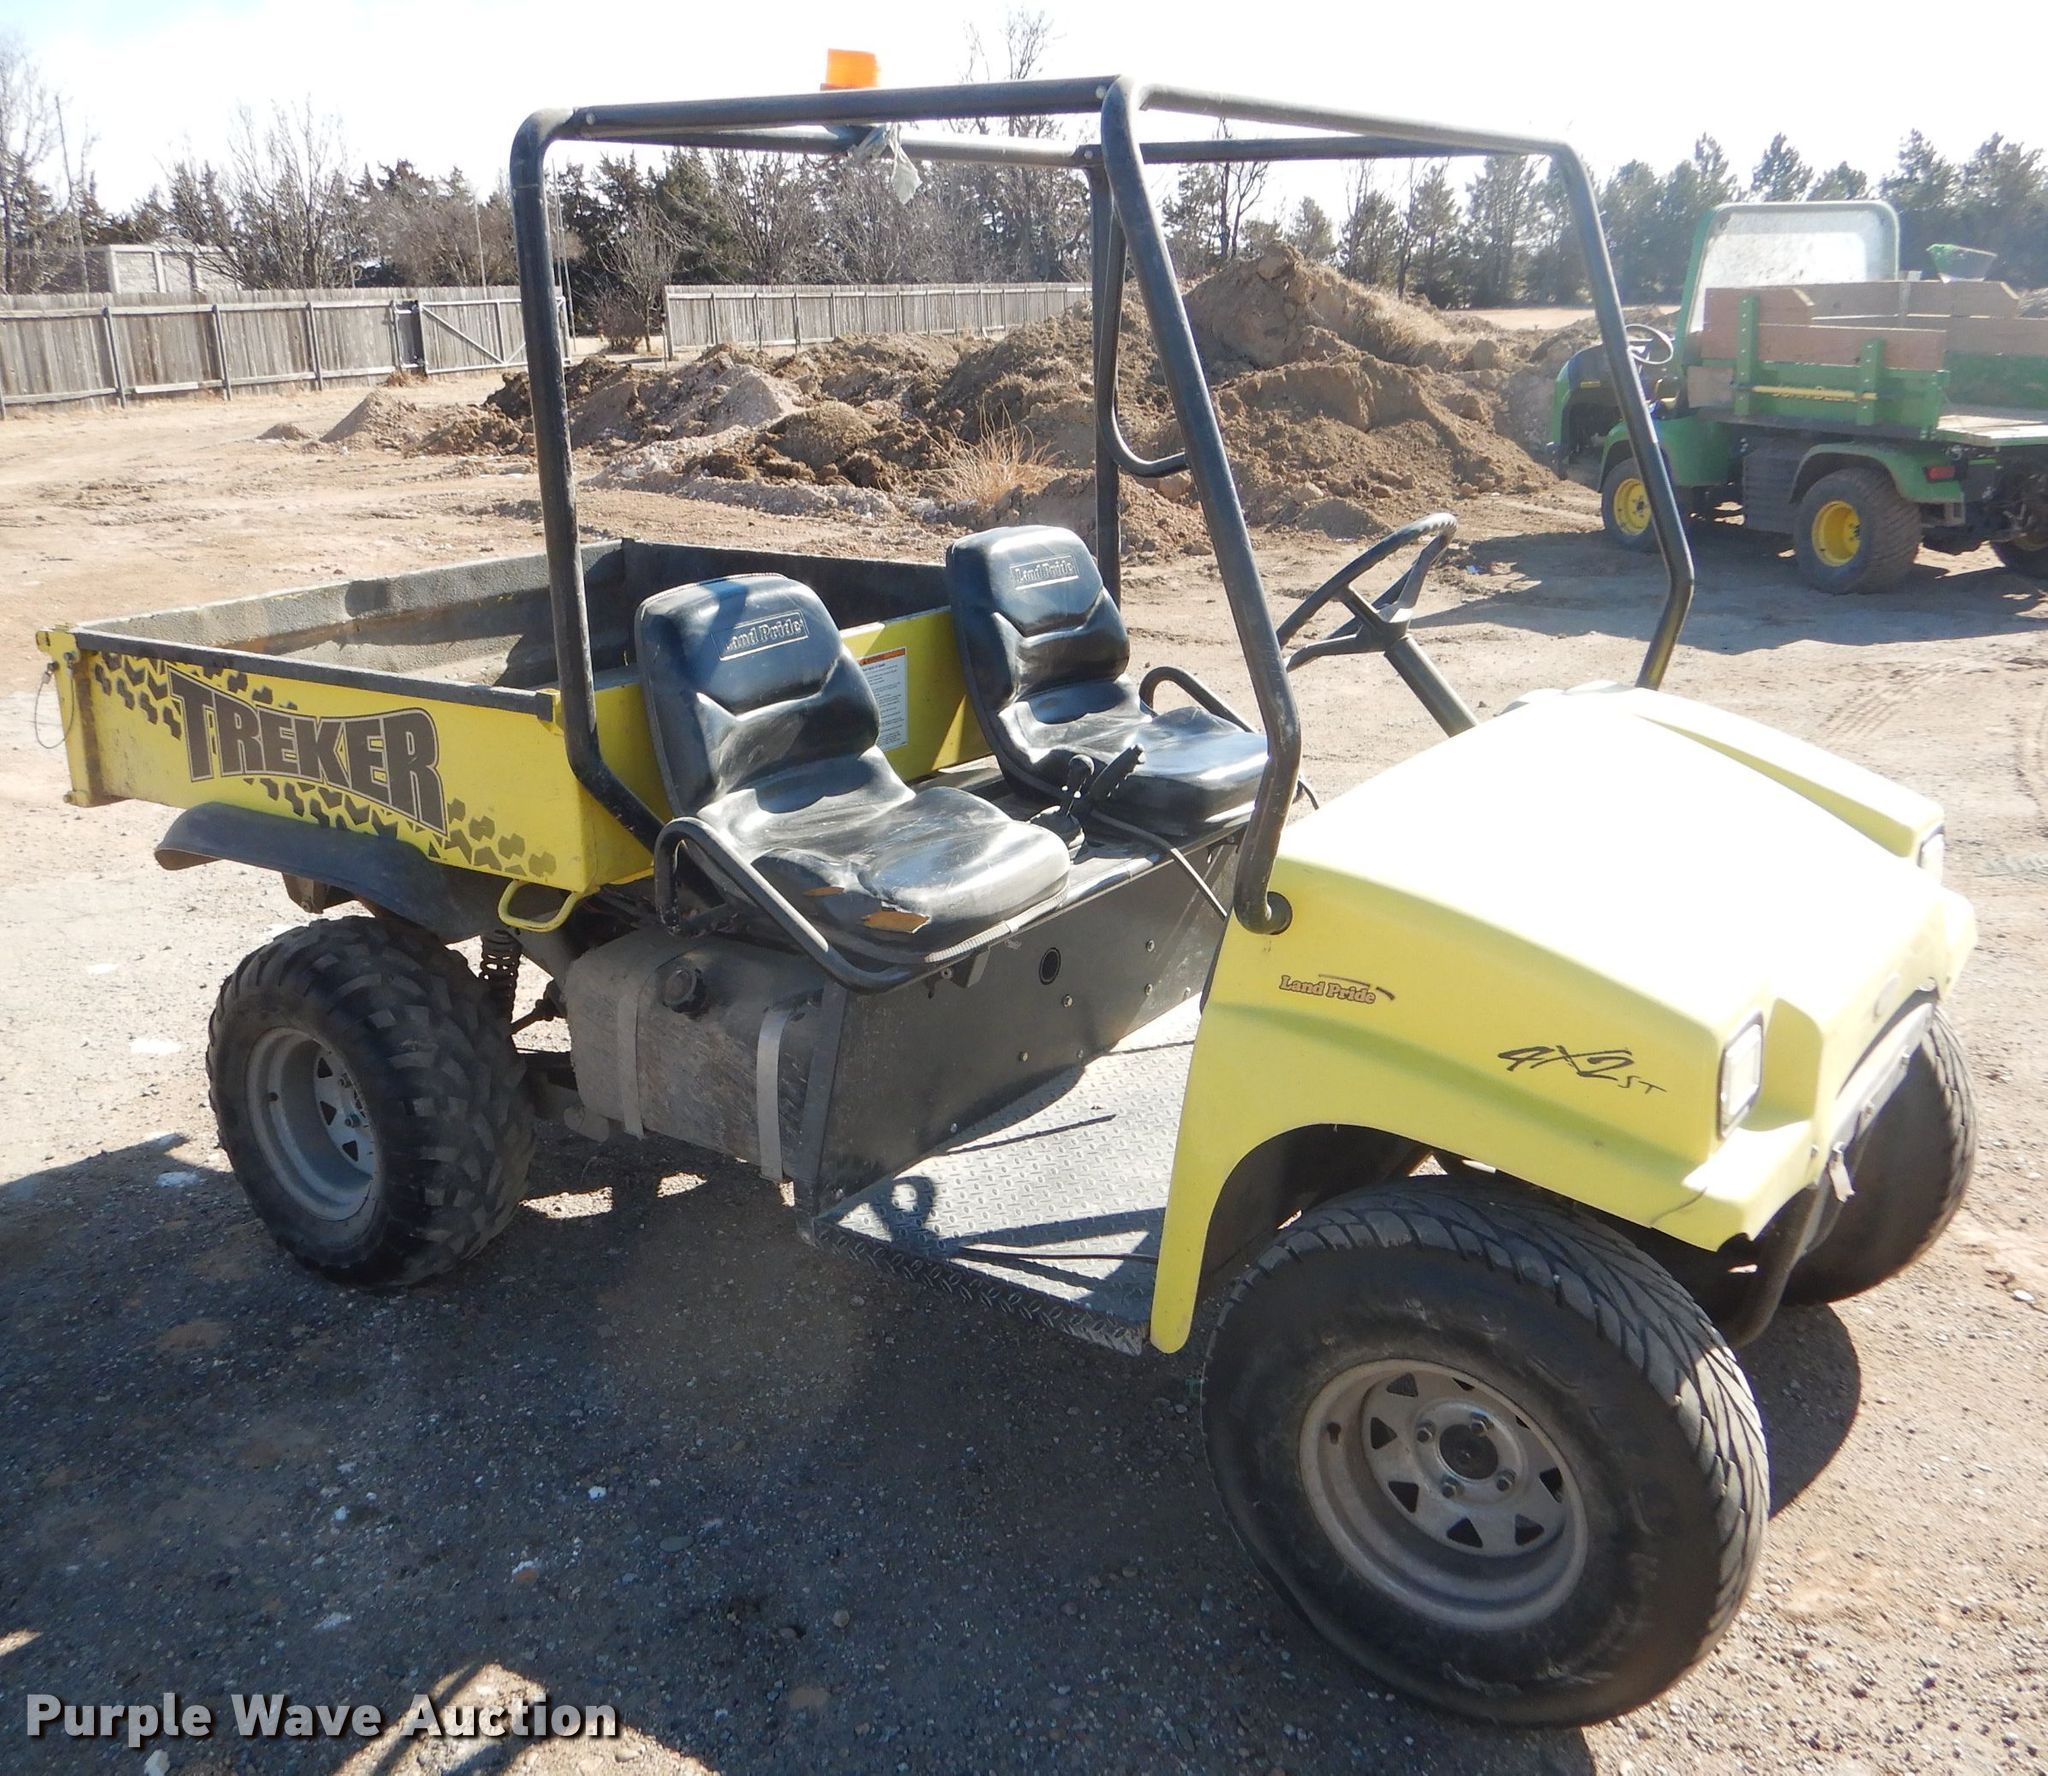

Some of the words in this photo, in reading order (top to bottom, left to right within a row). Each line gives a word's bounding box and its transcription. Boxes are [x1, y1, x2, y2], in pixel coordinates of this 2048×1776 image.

[1014, 565, 1042, 583] Land
[1041, 560, 1074, 579] Pride
[758, 618, 802, 643] Pride
[165, 660, 449, 837] TREKER
[1279, 975, 1325, 996] Land
[1325, 982, 1377, 1005] Pride
